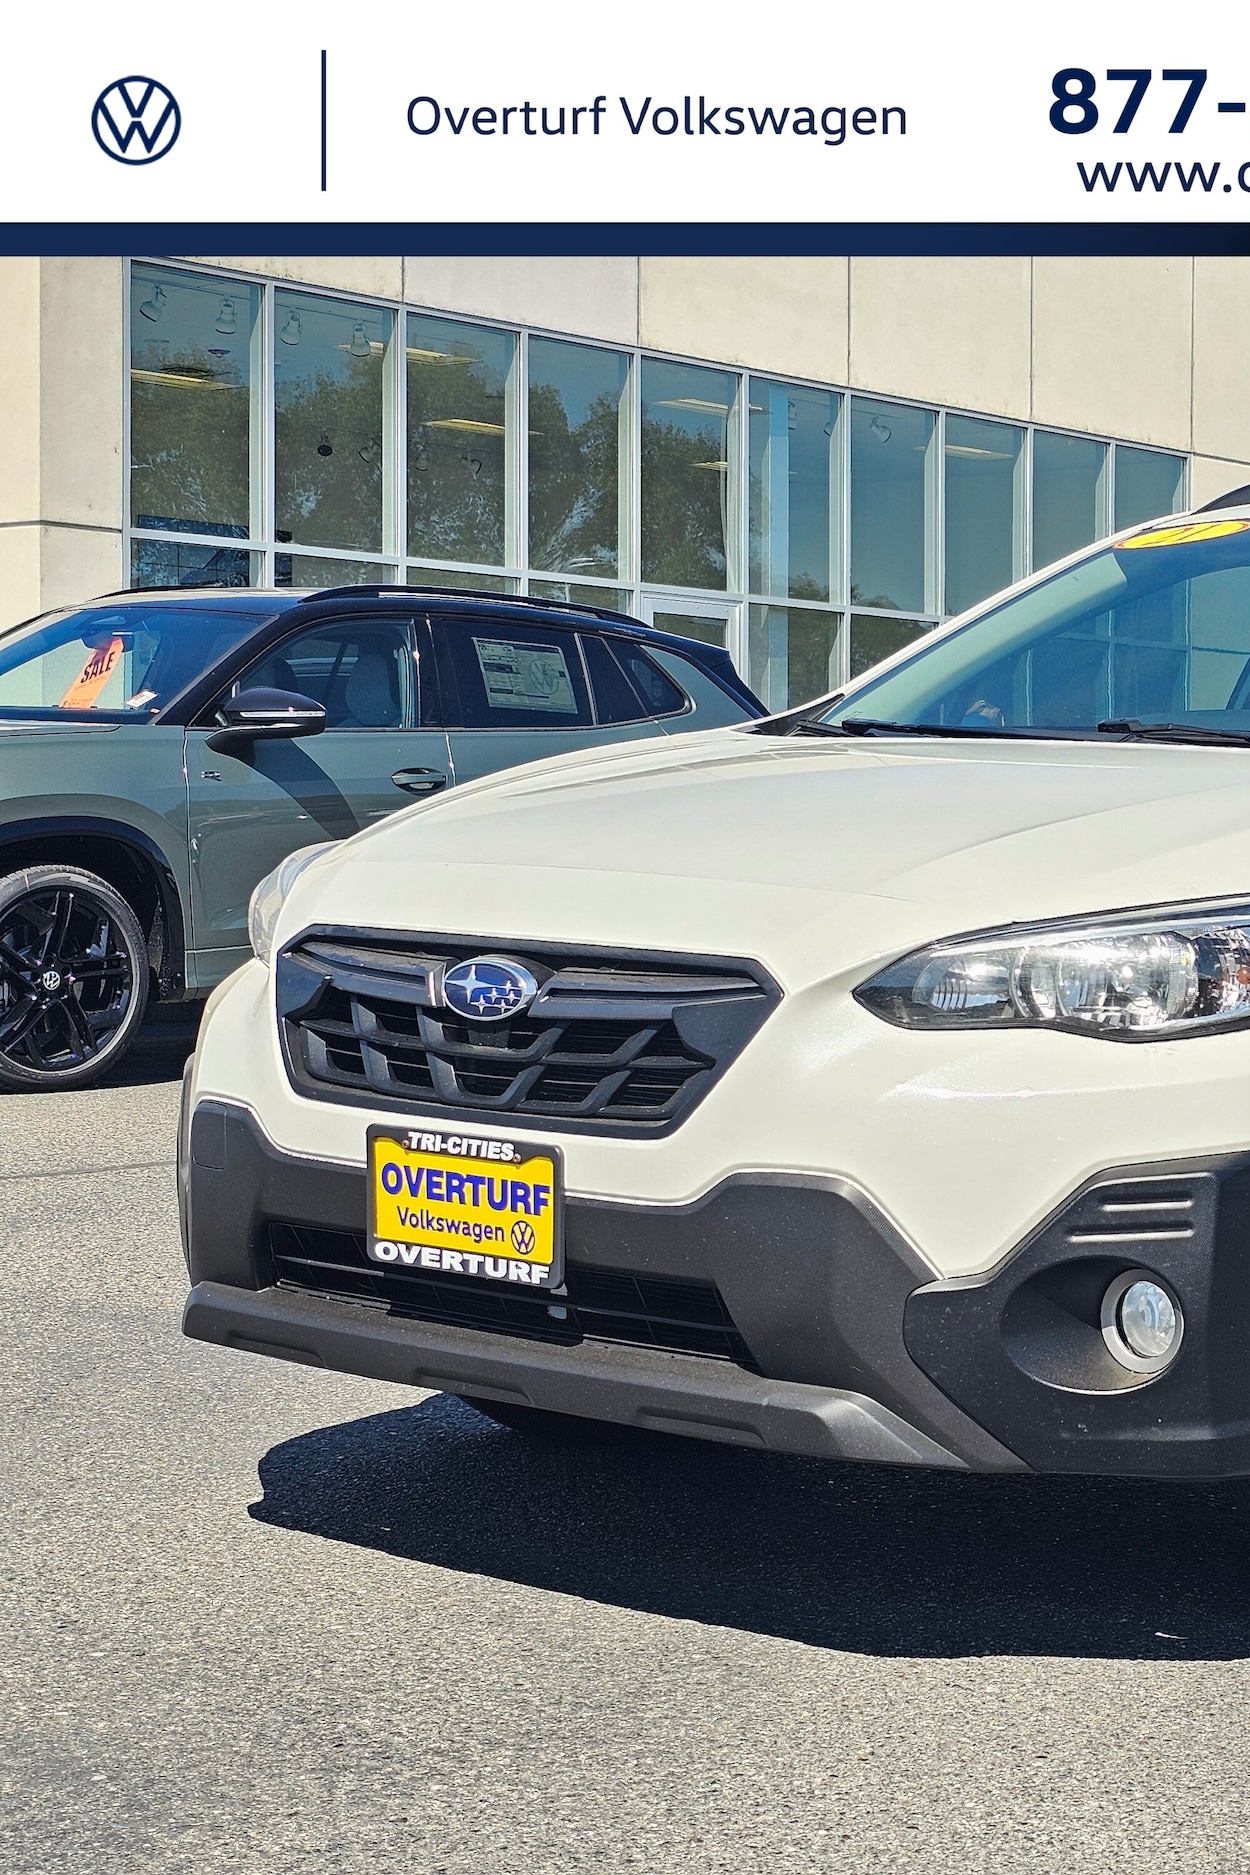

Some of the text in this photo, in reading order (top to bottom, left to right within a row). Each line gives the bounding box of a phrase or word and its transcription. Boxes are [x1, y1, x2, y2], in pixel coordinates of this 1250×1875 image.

[80, 651, 116, 684] SALE
[408, 1131, 515, 1162] TRI-CITIES
[381, 1162, 551, 1216] OVERTURF
[397, 1205, 505, 1243] Volkswagen
[374, 1241, 550, 1285] OVERTURF
